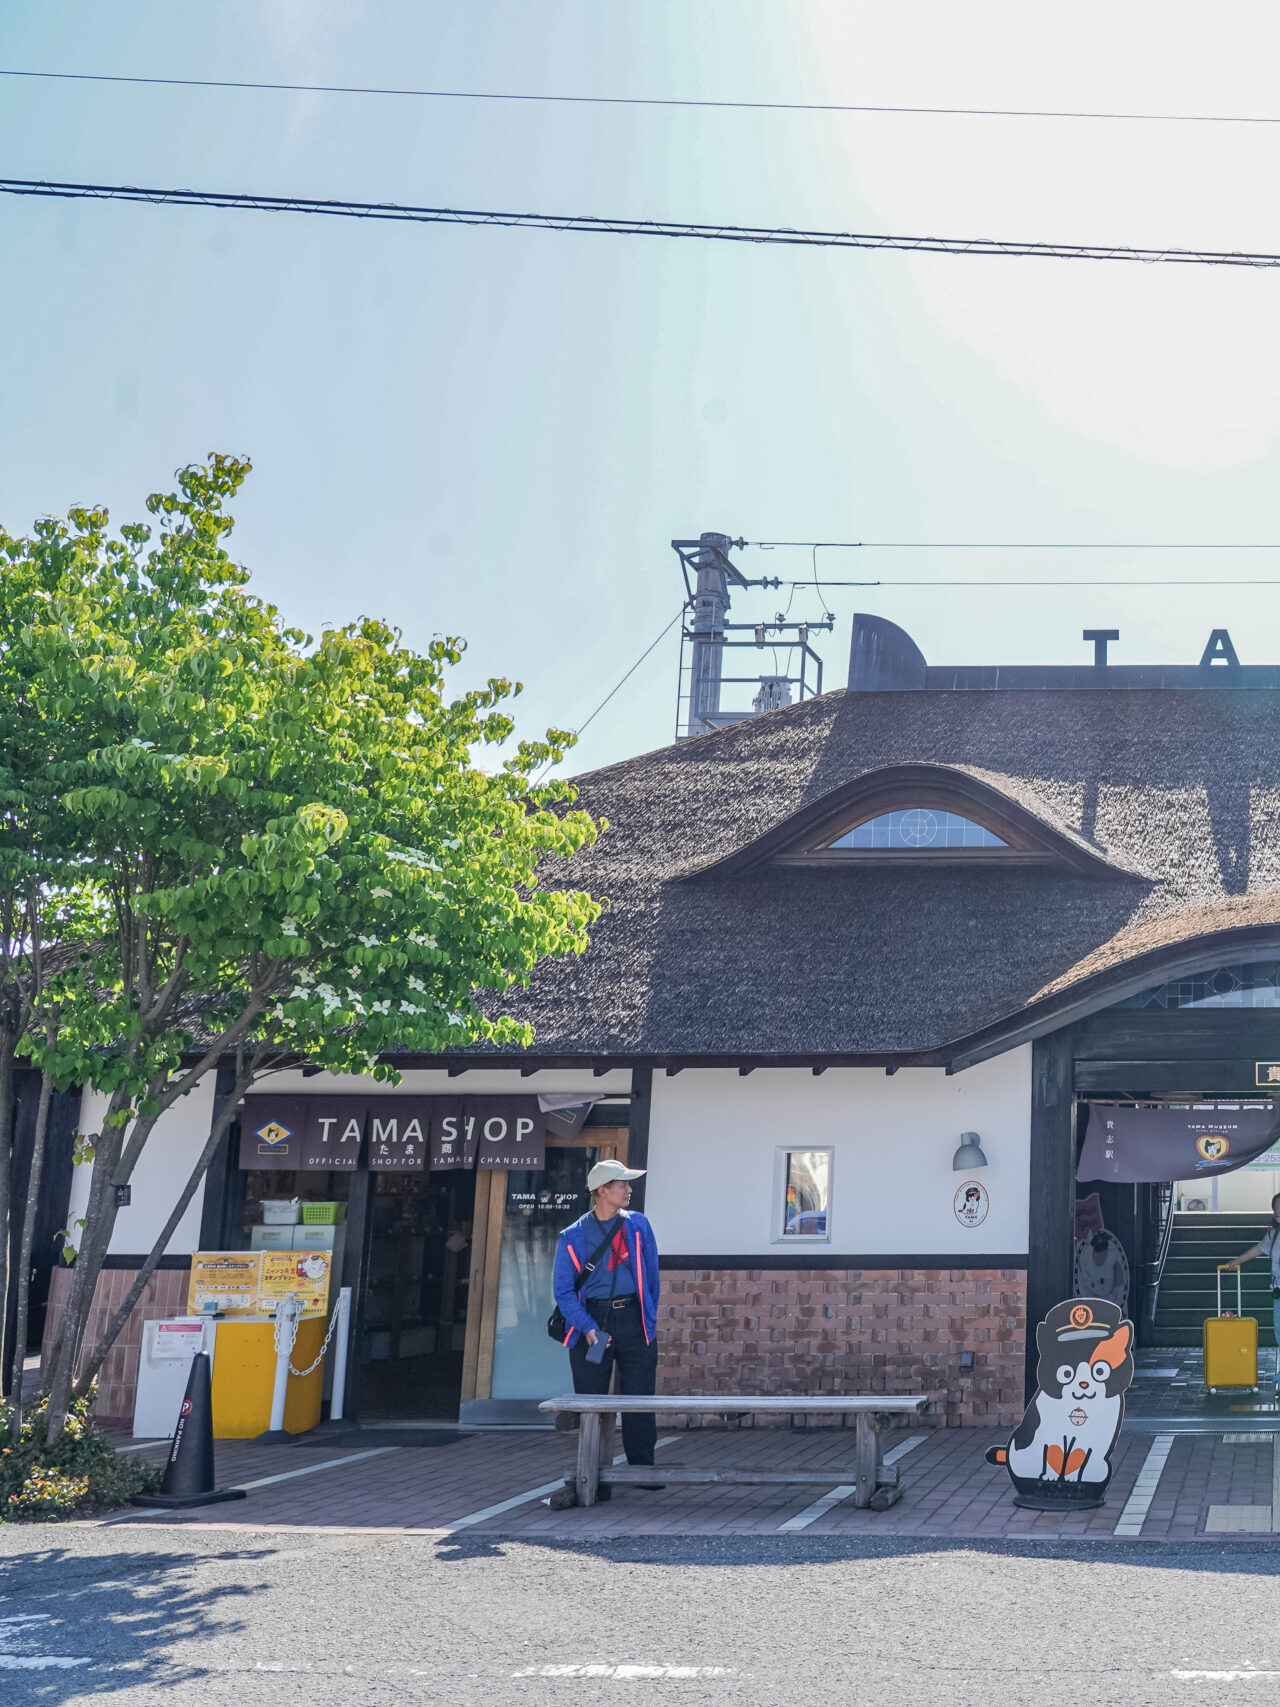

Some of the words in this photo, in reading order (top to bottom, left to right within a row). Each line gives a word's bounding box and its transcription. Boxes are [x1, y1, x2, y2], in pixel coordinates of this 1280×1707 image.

[318, 1118, 424, 1143] TAMA
[441, 1116, 534, 1142] SHOP
[1105, 1120, 1115, 1159] 貴志駅
[178, 1418, 185, 1429] NO
[171, 1430, 183, 1462] PARKING
